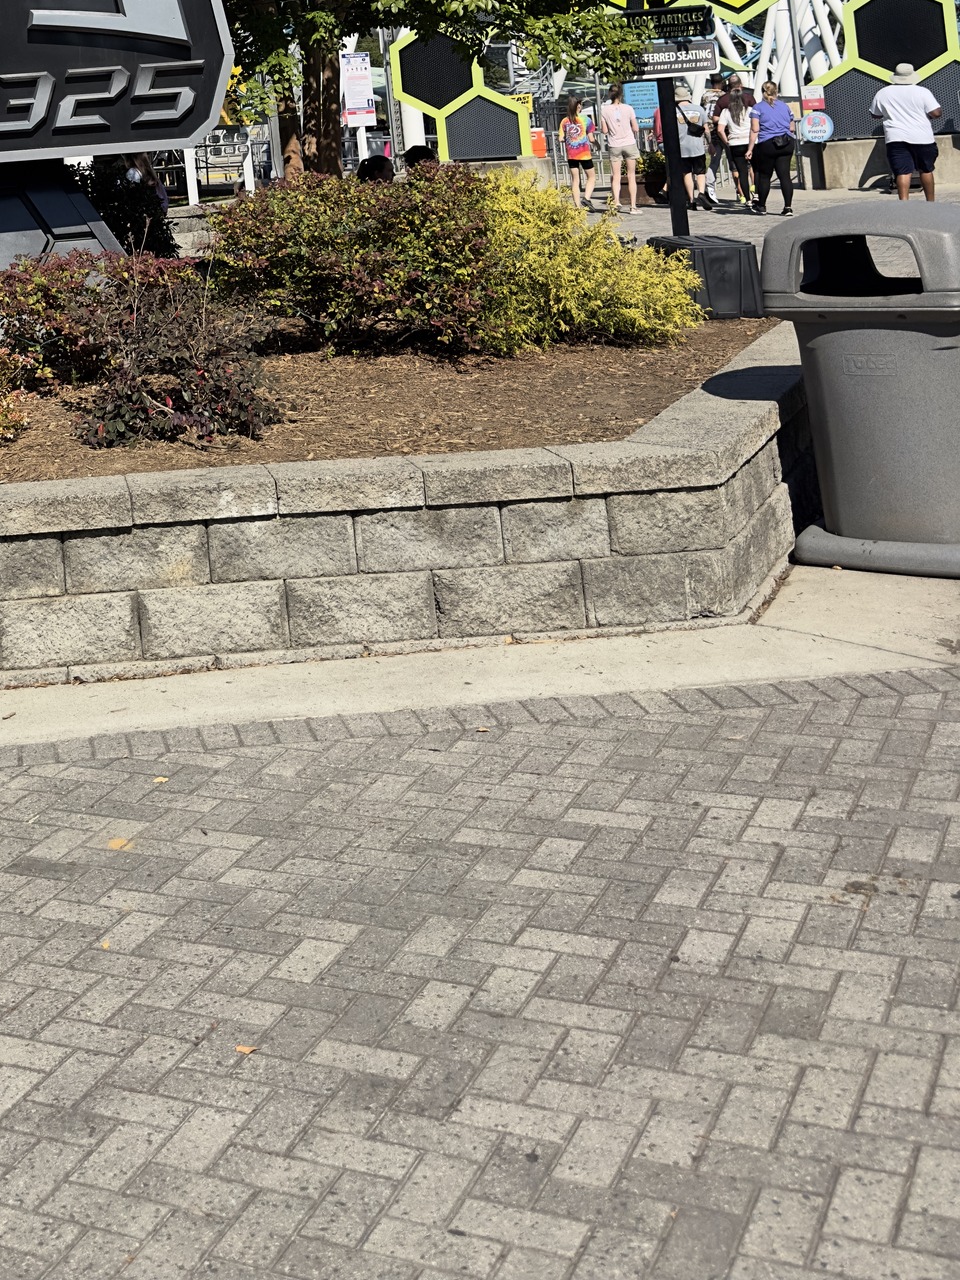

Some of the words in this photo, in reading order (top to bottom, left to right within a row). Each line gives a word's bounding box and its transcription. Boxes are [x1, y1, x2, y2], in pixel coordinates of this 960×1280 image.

[660, 11, 703, 25] ARTICLES
[628, 52, 676, 64] PREFERRED
[677, 49, 712, 61] SEATING
